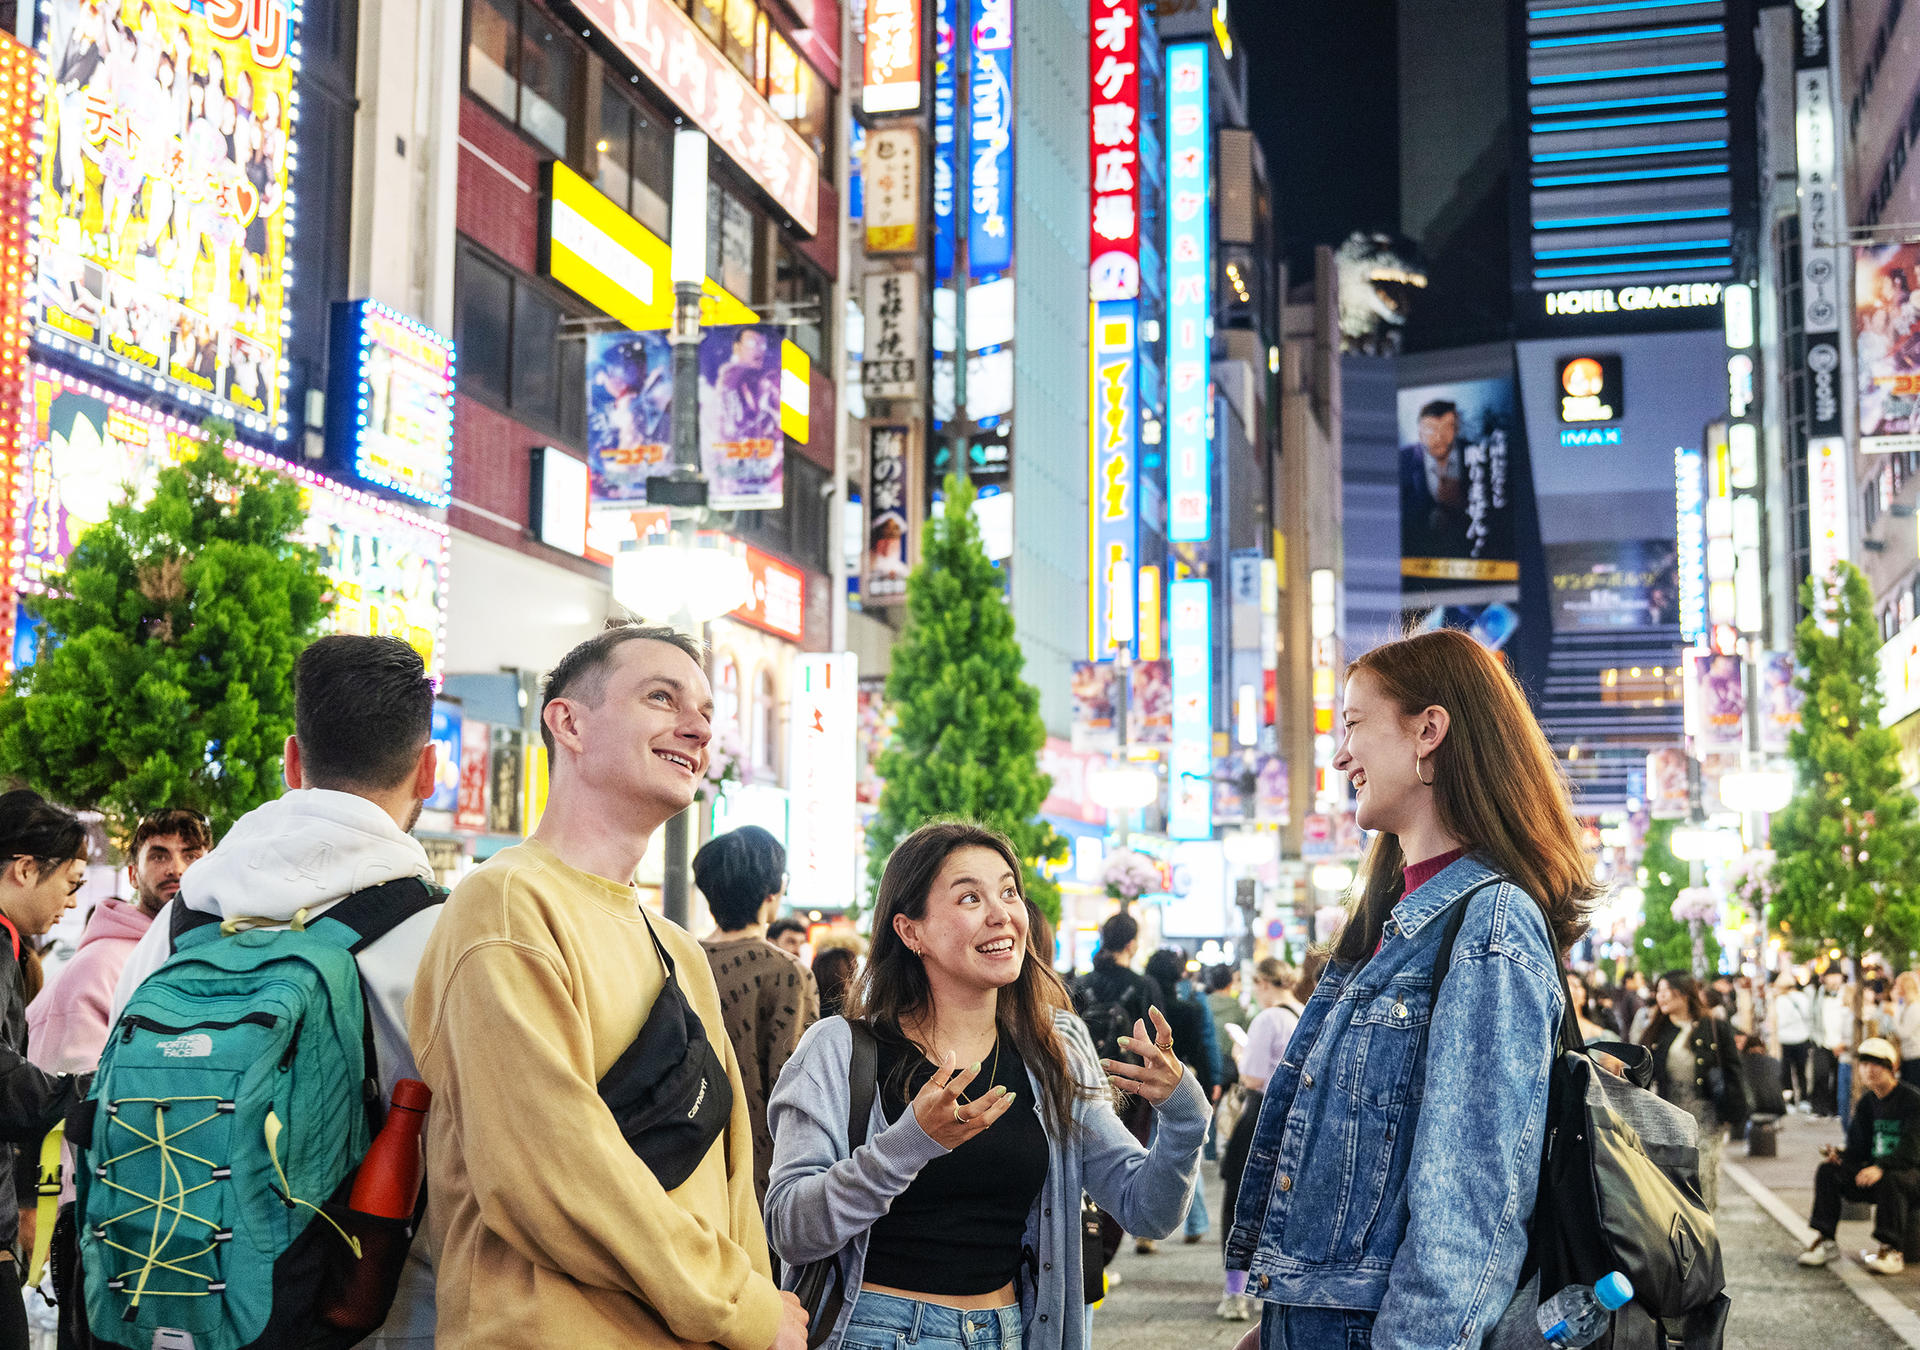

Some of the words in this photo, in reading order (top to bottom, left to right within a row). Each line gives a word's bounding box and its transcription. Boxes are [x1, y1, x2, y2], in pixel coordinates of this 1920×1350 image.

[1093, 0, 1135, 241] オケ歌広場
[1545, 289, 1619, 316] HOTEL
[1618, 282, 1722, 311] GRACERY
[1560, 427, 1622, 447] IMAX
[163, 1048, 193, 1057] FACE
